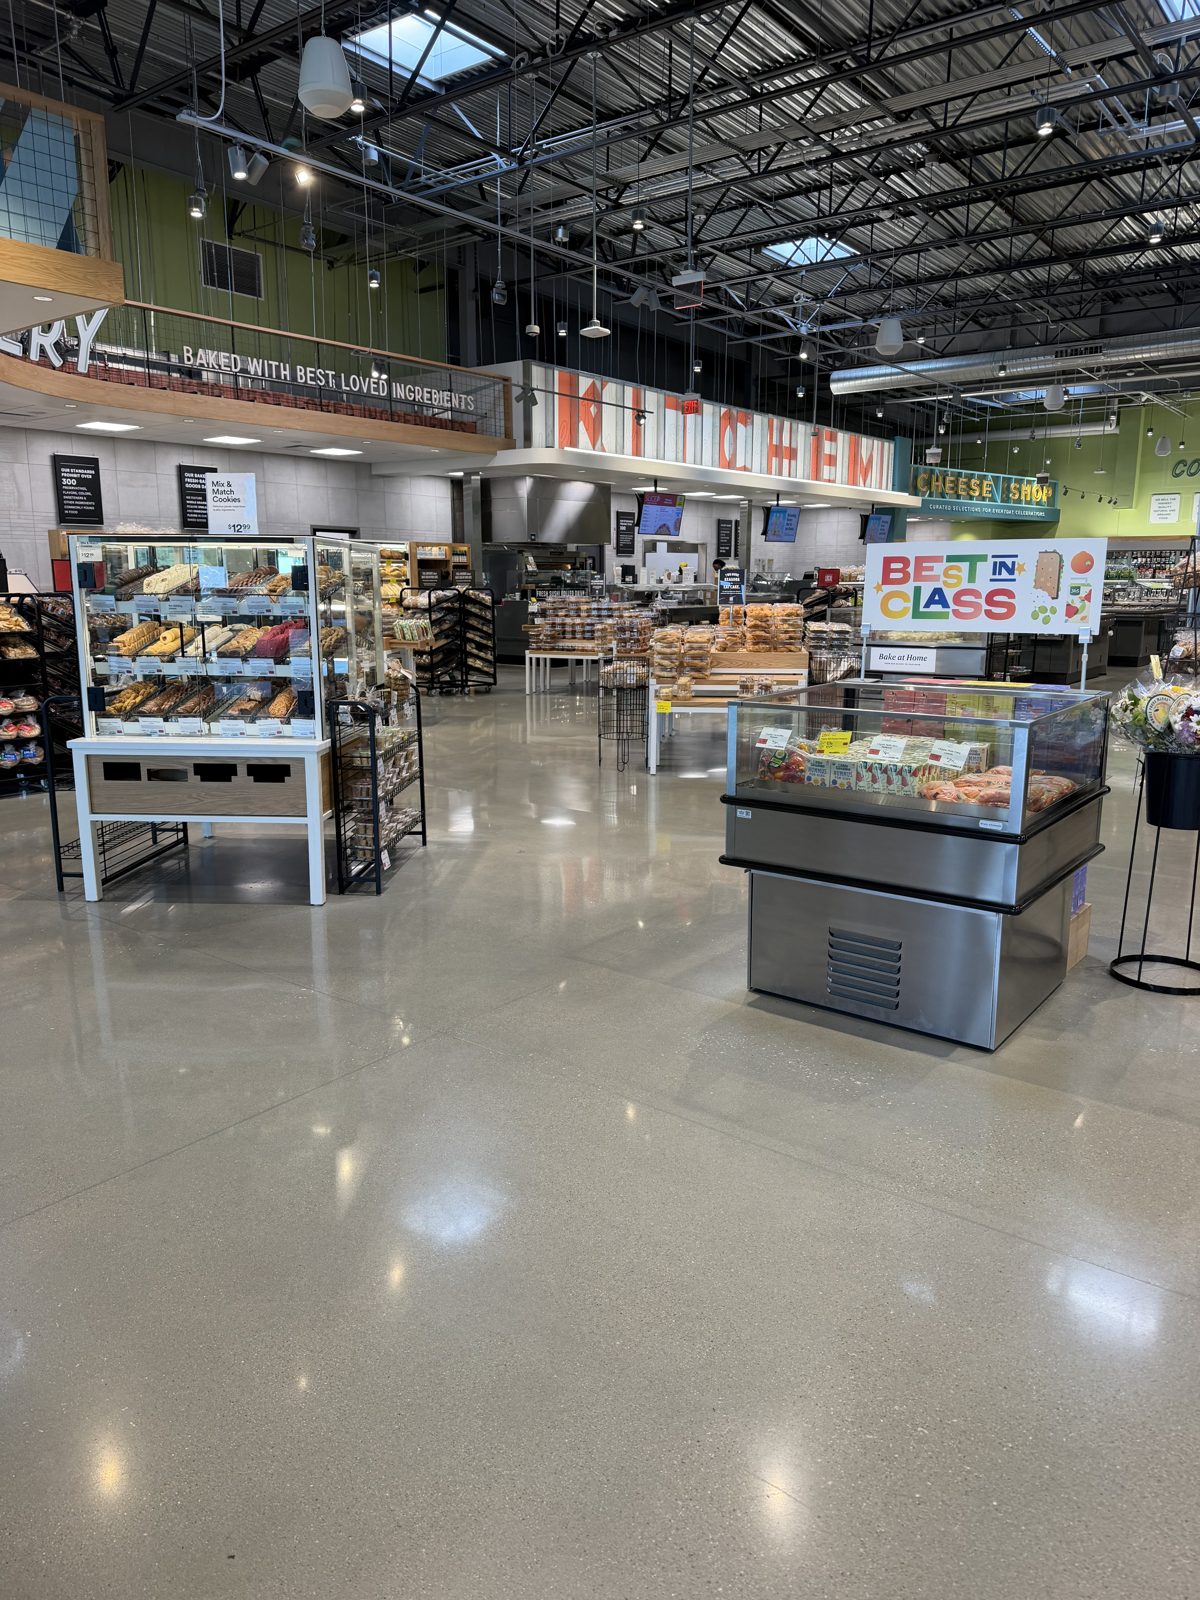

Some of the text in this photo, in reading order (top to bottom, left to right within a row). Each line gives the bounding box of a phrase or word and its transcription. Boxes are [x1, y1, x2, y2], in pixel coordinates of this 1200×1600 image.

[182, 346, 475, 411] BAKED WITH BEST LOVED INGREDIENTS
[684, 400, 698, 414] EXIT
[917, 472, 1052, 503] CHEESE SHOP
[882, 554, 1016, 588] BEST IN
[880, 586, 1017, 620] CLASS
